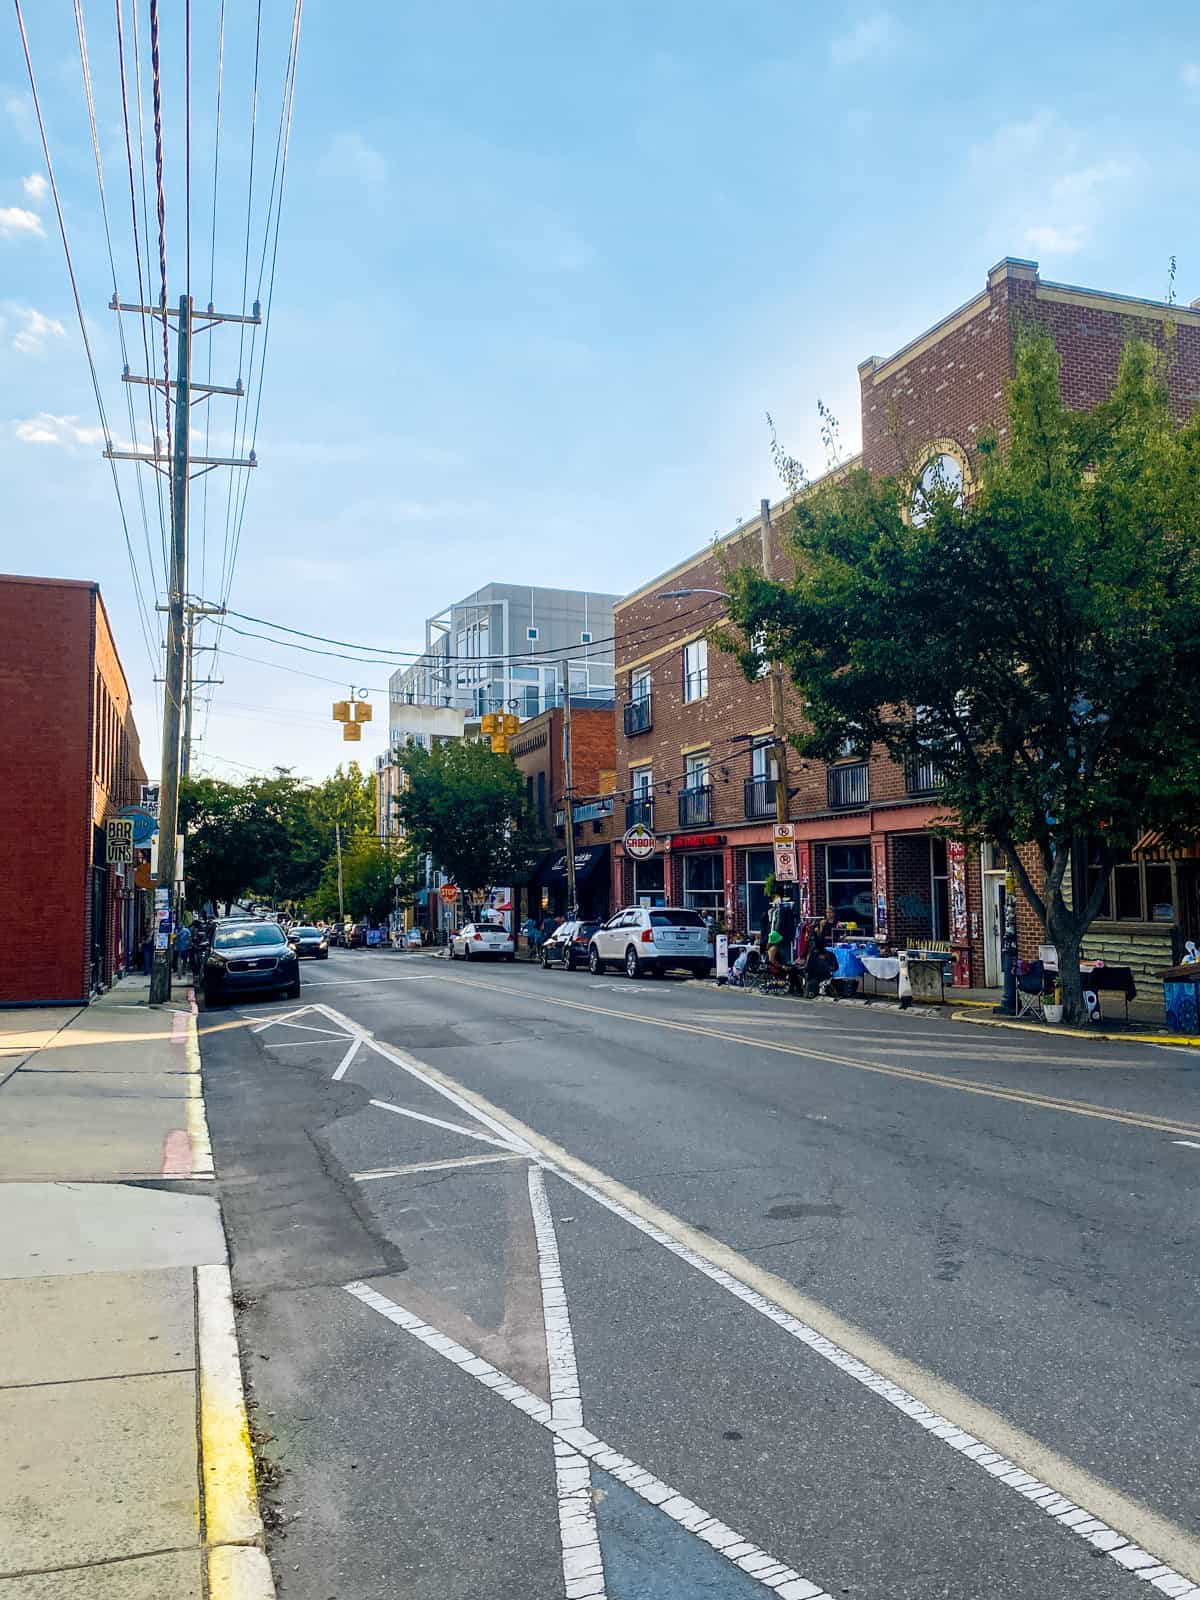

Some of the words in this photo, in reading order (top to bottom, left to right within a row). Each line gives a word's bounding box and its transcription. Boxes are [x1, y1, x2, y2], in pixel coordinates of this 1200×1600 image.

[108, 822, 132, 839] BAR
[626, 838, 656, 848] SABOR
[108, 846, 132, 861] VINS
[440, 888, 457, 897] STOP
